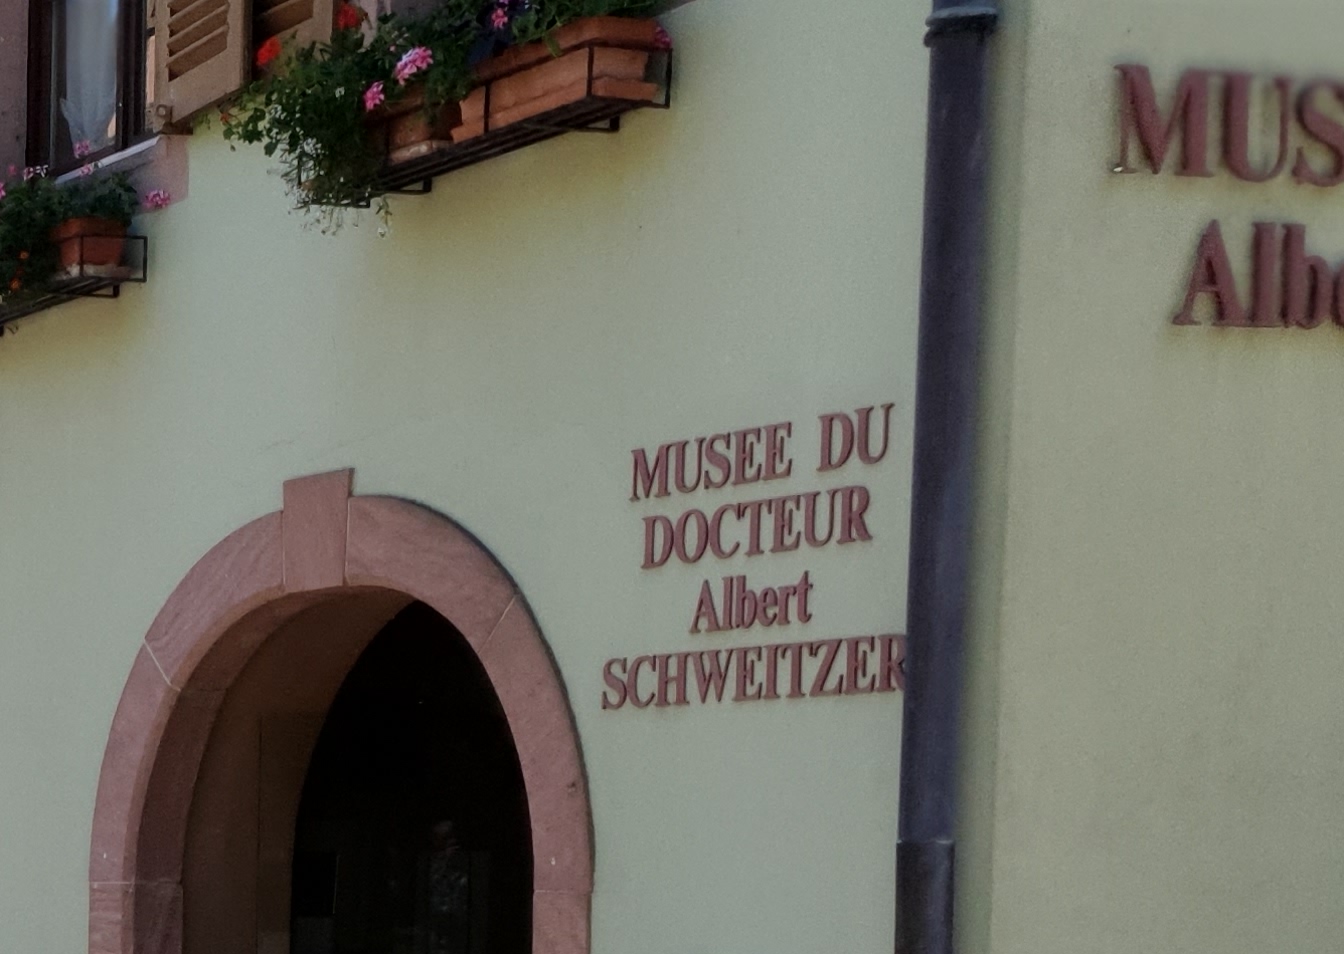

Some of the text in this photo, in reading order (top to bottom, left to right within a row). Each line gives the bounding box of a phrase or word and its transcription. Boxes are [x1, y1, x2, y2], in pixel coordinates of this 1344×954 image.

[1172, 219, 1344, 329] Alb
[629, 402, 895, 502] MUSEE DU
[640, 485, 873, 570] DOCTEUR
[689, 570, 813, 634] Albert
[602, 633, 906, 710] SCHWEITZER
